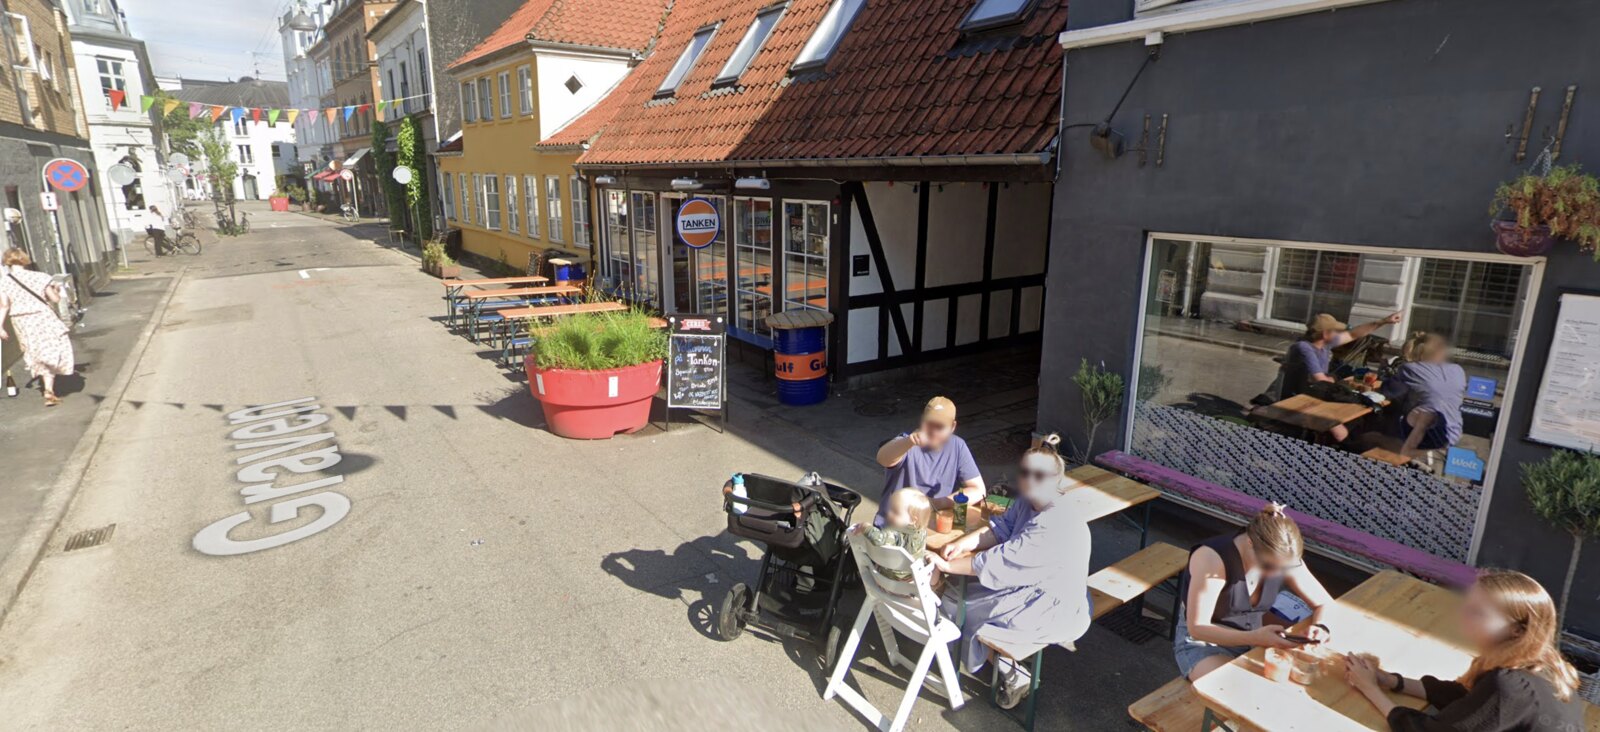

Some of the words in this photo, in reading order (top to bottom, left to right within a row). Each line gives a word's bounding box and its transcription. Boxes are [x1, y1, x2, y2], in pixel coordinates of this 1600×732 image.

[680, 218, 716, 230] TANKEN
[776, 361, 794, 373] ulf
[1452, 457, 1478, 470] Wolt
